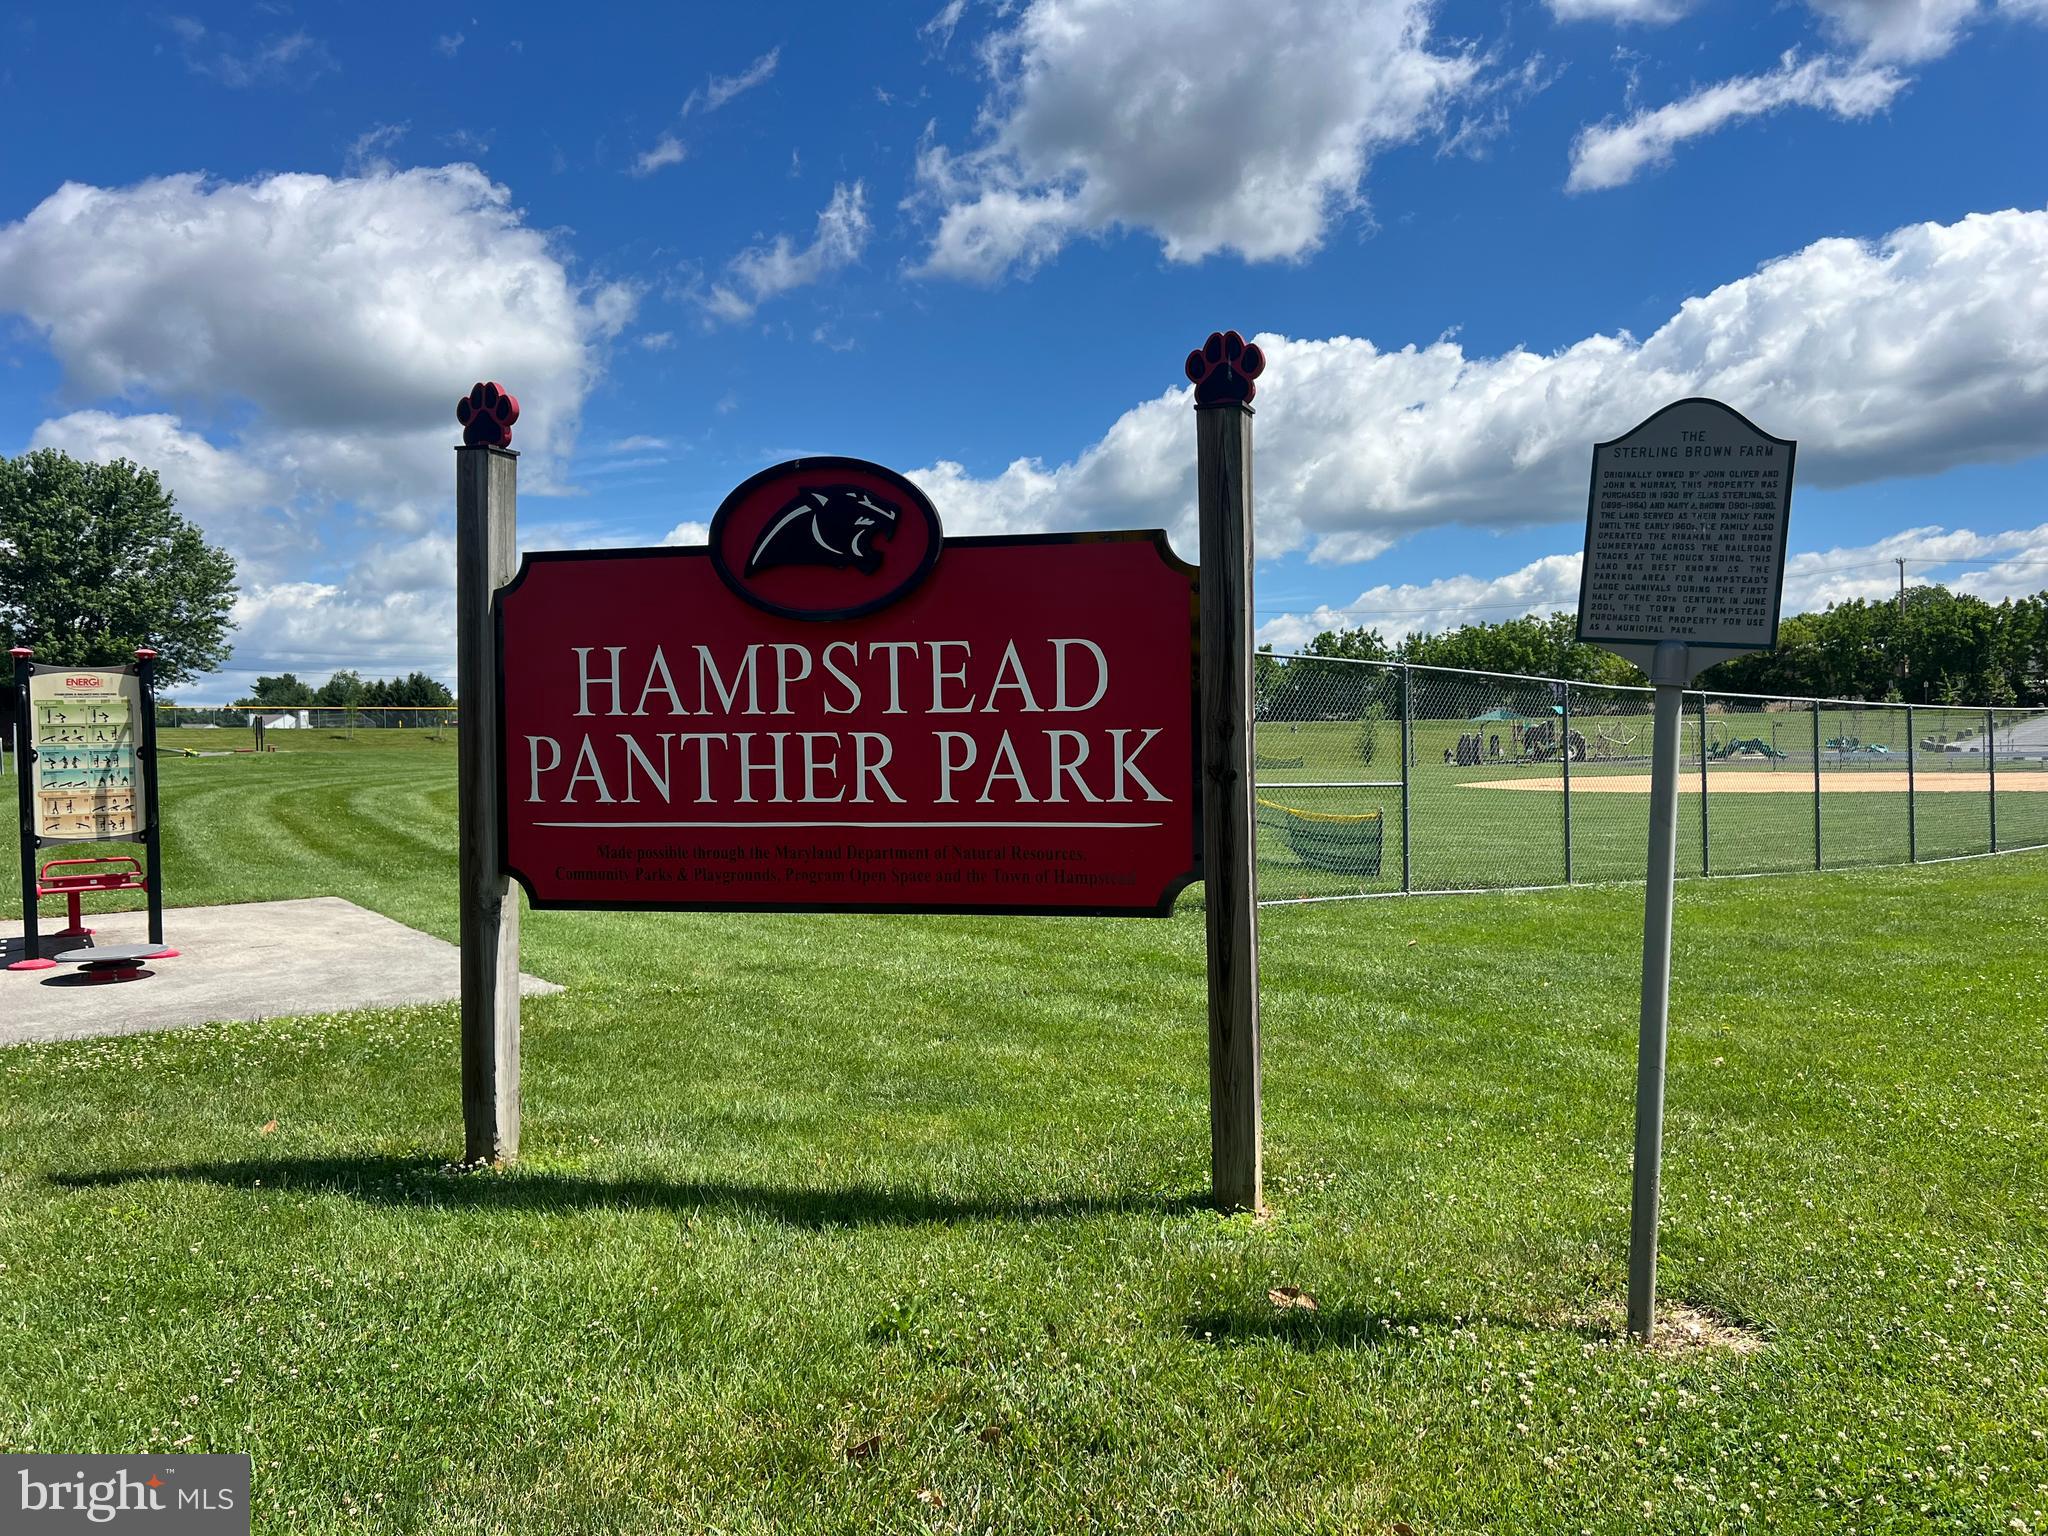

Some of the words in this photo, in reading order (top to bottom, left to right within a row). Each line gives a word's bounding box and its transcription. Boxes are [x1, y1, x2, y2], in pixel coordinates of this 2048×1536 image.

[1681, 430, 1706, 442] THE
[1613, 447, 1678, 458] STERLING
[1685, 446, 1732, 457] BROWN
[1739, 446, 1774, 457] FARM
[1603, 471, 1652, 479] ORIGINALLY
[1656, 471, 1685, 479] OWNED
[1689, 471, 1699, 479] BY
[1703, 470, 1725, 478] JOHN
[1729, 470, 1760, 478] OLIVER
[1762, 470, 1779, 478] AND
[1603, 481, 1625, 489] JOHN
[1640, 481, 1677, 490] MURRAY,
[1682, 481, 1702, 489] THIS
[1707, 481, 1754, 489] PROPERTY
[1760, 481, 1778, 489] WAS
[1601, 491, 1646, 500] PURCHASED
[1660, 492, 1679, 500] 1930
[1698, 491, 1720, 499] ELIAS
[1649, 502, 1664, 510] AND
[1667, 502, 1688, 510] MARY
[1699, 502, 1725, 510] BROWN
[1600, 512, 1615, 520] THE
[1619, 512, 1640, 520] LAND
[1642, 512, 1674, 520] SERVED
[1678, 512, 1688, 520] AS
[1692, 512, 1716, 520] THEIR
[1720, 512, 1749, 520] FAMILY
[1753, 512, 1775, 520] FARM
[1599, 522, 1621, 530] UNTIL
[1624, 522, 1640, 530] THE
[1644, 522, 1670, 530] EARLY
[1699, 522, 1715, 531] THE
[1720, 522, 1750, 531] FAMILY
[1752, 523, 1774, 531] ALSO
[1598, 532, 1642, 540] OPERATED
[1671, 533, 1711, 541] RINAMAN
[1718, 533, 1735, 541] AND
[1742, 534, 1773, 542] BROWN
[1597, 542, 1655, 551] LUMBERYARD
[1661, 543, 1696, 551] ACROSS
[1702, 544, 1719, 552] THE
[1725, 544, 1772, 552] RAILROAD
[1634, 553, 1645, 561] AT
[1651, 553, 1667, 561] THE
[1673, 554, 1704, 562] HOUCK
[1750, 555, 1771, 563] THIS
[1626, 563, 1643, 571] WAS
[1651, 564, 1677, 572] BEST
[1685, 564, 1718, 572] KNOWN
[1750, 566, 1769, 574] THE
[1593, 573, 1633, 581] PARKING
[1703, 575, 1768, 584] HAMPSTEAD'S
[1592, 583, 1619, 591] LARGE
[1625, 584, 1671, 592] CARNIVALS
[1677, 585, 1711, 593] DURING
[1717, 586, 1734, 594] THE
[1740, 587, 1768, 595] FIRST
[1592, 593, 1614, 601] HALF
[1634, 594, 1651, 602] THE
[1729, 597, 1738, 605] IN
[1743, 598, 1767, 606] JUNE
[1649, 604, 1675, 613] TOWN
[1706, 606, 1766, 616] HAMPSTEAD
[1590, 613, 1640, 622] PURCHASED
[1646, 615, 1662, 623] THE
[1668, 616, 1717, 625] PROPERTY
[1723, 618, 1741, 626] FOR
[1746, 619, 1765, 627] USE
[1589, 623, 1600, 631] AS
[1616, 624, 1665, 633] MUNICIPAL
[1671, 626, 1696, 634] PARK.
[571, 638, 1109, 717] HAMPSTEAD
[523, 731, 907, 804] PANTHER
[931, 727, 1173, 804] PARK
[597, 844, 632, 860] Made
[637, 845, 689, 862] possible
[692, 845, 744, 862] through
[749, 845, 769, 860] the
[775, 845, 841, 863] Maryland
[847, 845, 929, 863] Department
[934, 846, 949, 861] of
[953, 845, 1004, 861] Natural
[555, 866, 629, 886] Community
[635, 867, 672, 882] Parks
[677, 868, 689, 882] &
[785, 867, 844, 886] Program
[850, 867, 886, 886] Open
[891, 867, 930, 885] Space
[935, 868, 961, 883] and
[966, 867, 989, 883] the
[992, 867, 1030, 883] Town
[1035, 868, 1049, 883] of
